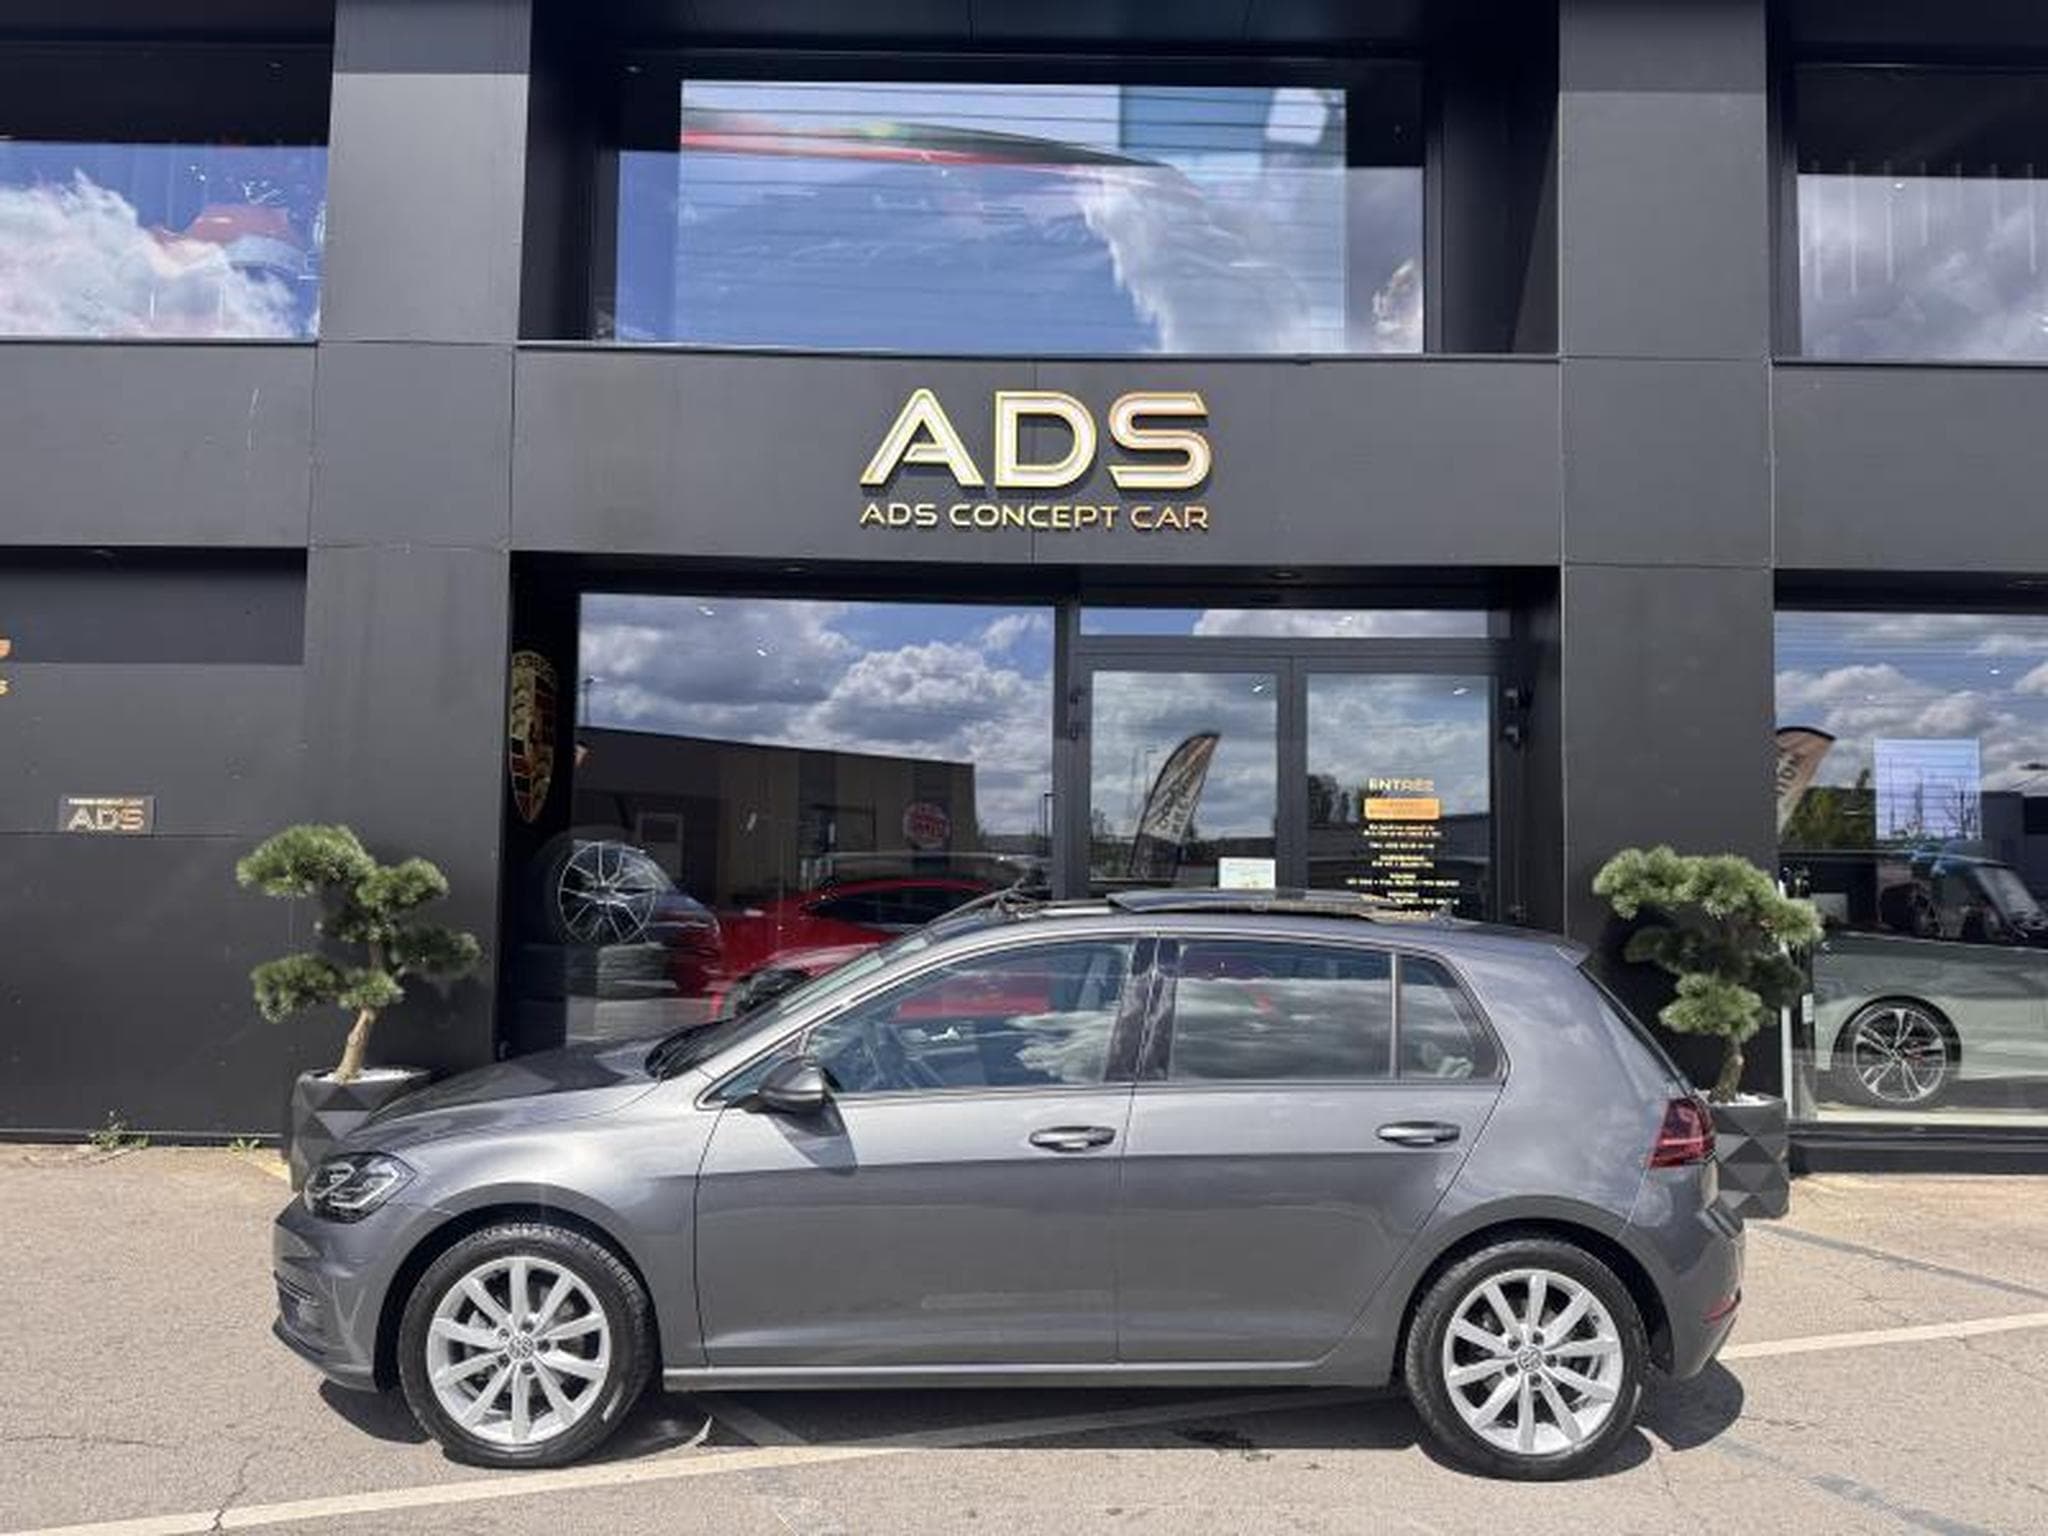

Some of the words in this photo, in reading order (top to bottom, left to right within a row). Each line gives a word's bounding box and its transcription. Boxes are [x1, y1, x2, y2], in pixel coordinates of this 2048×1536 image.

[859, 388, 1212, 489] ADS
[860, 503, 938, 527] ADS
[950, 504, 1119, 529] CONCEPT
[1130, 505, 1210, 530] CAR
[67, 806, 144, 831] ADS
